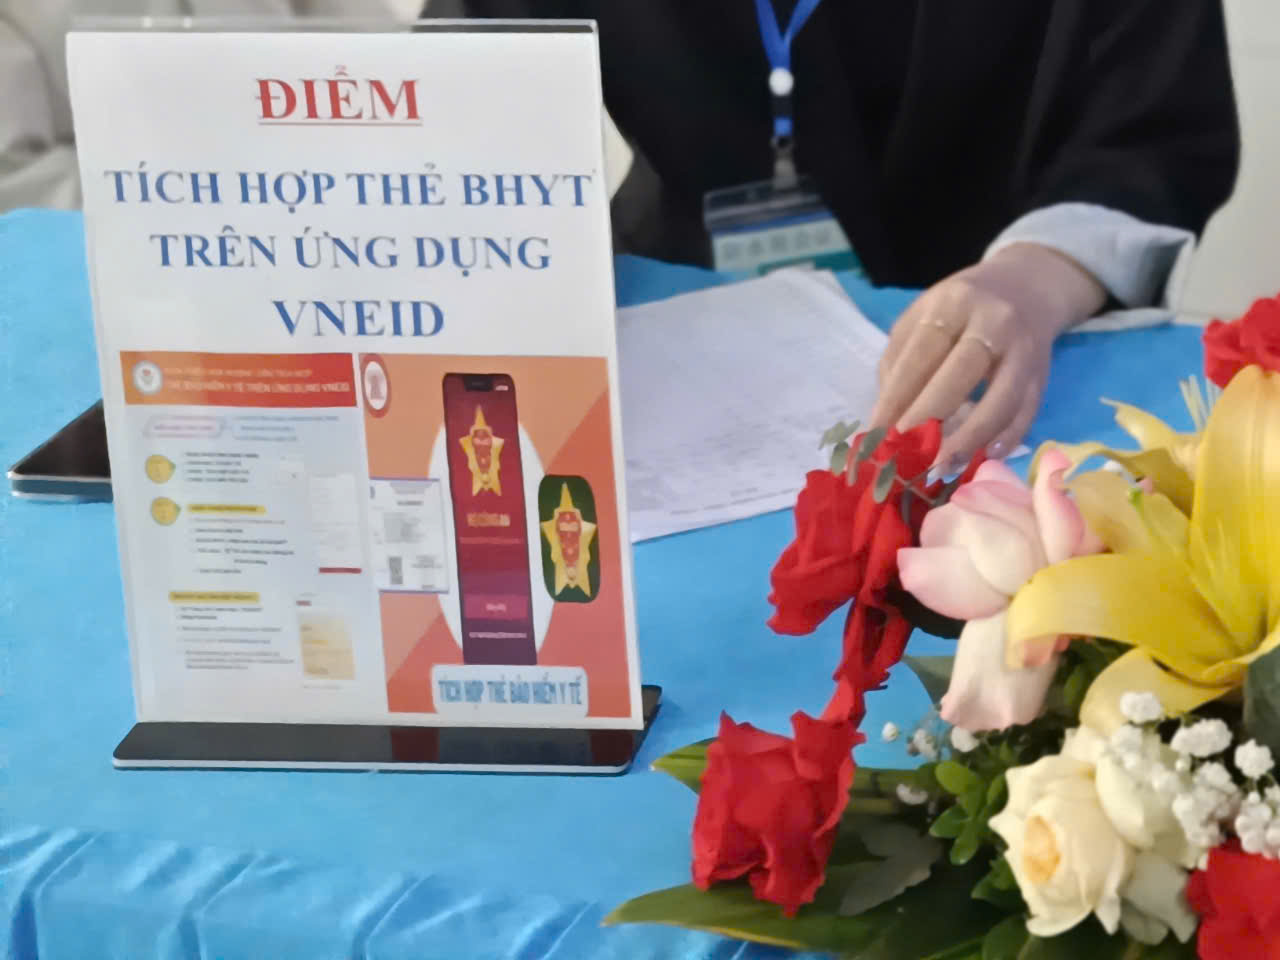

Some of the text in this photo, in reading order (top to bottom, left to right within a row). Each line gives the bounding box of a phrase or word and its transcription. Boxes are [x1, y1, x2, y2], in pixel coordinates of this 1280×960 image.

[255, 66, 421, 120] ĐIỂM
[105, 161, 593, 214] TÍCH HỢP THẺ BHYT
[150, 225, 551, 277] TRÊN ỨNG DỤNG
[271, 300, 445, 337] VNEID
